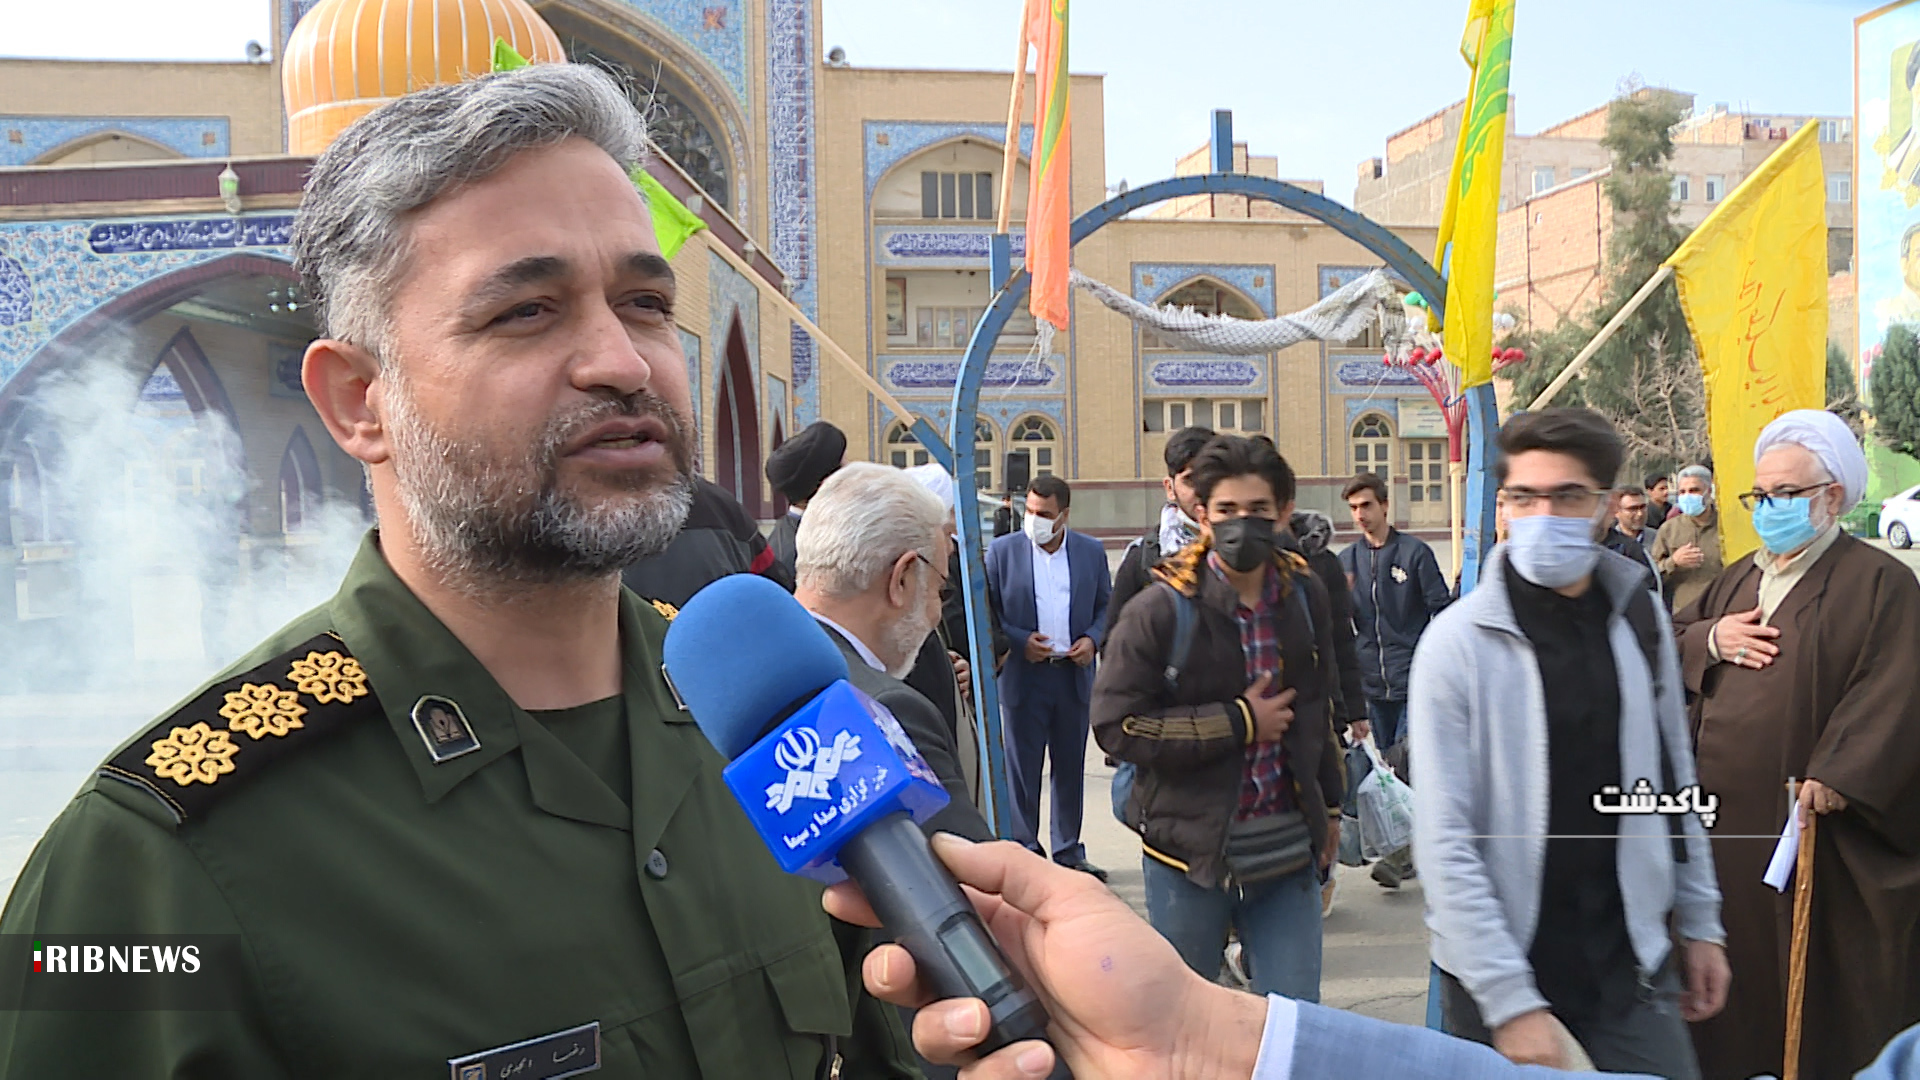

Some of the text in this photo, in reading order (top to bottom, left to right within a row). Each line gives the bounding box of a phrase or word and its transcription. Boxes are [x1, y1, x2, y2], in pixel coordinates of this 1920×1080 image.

[813, 805, 837, 826] صدا
[783, 827, 810, 850] سیما
[810, 823, 821, 838] و
[552, 1043, 586, 1063] رضا
